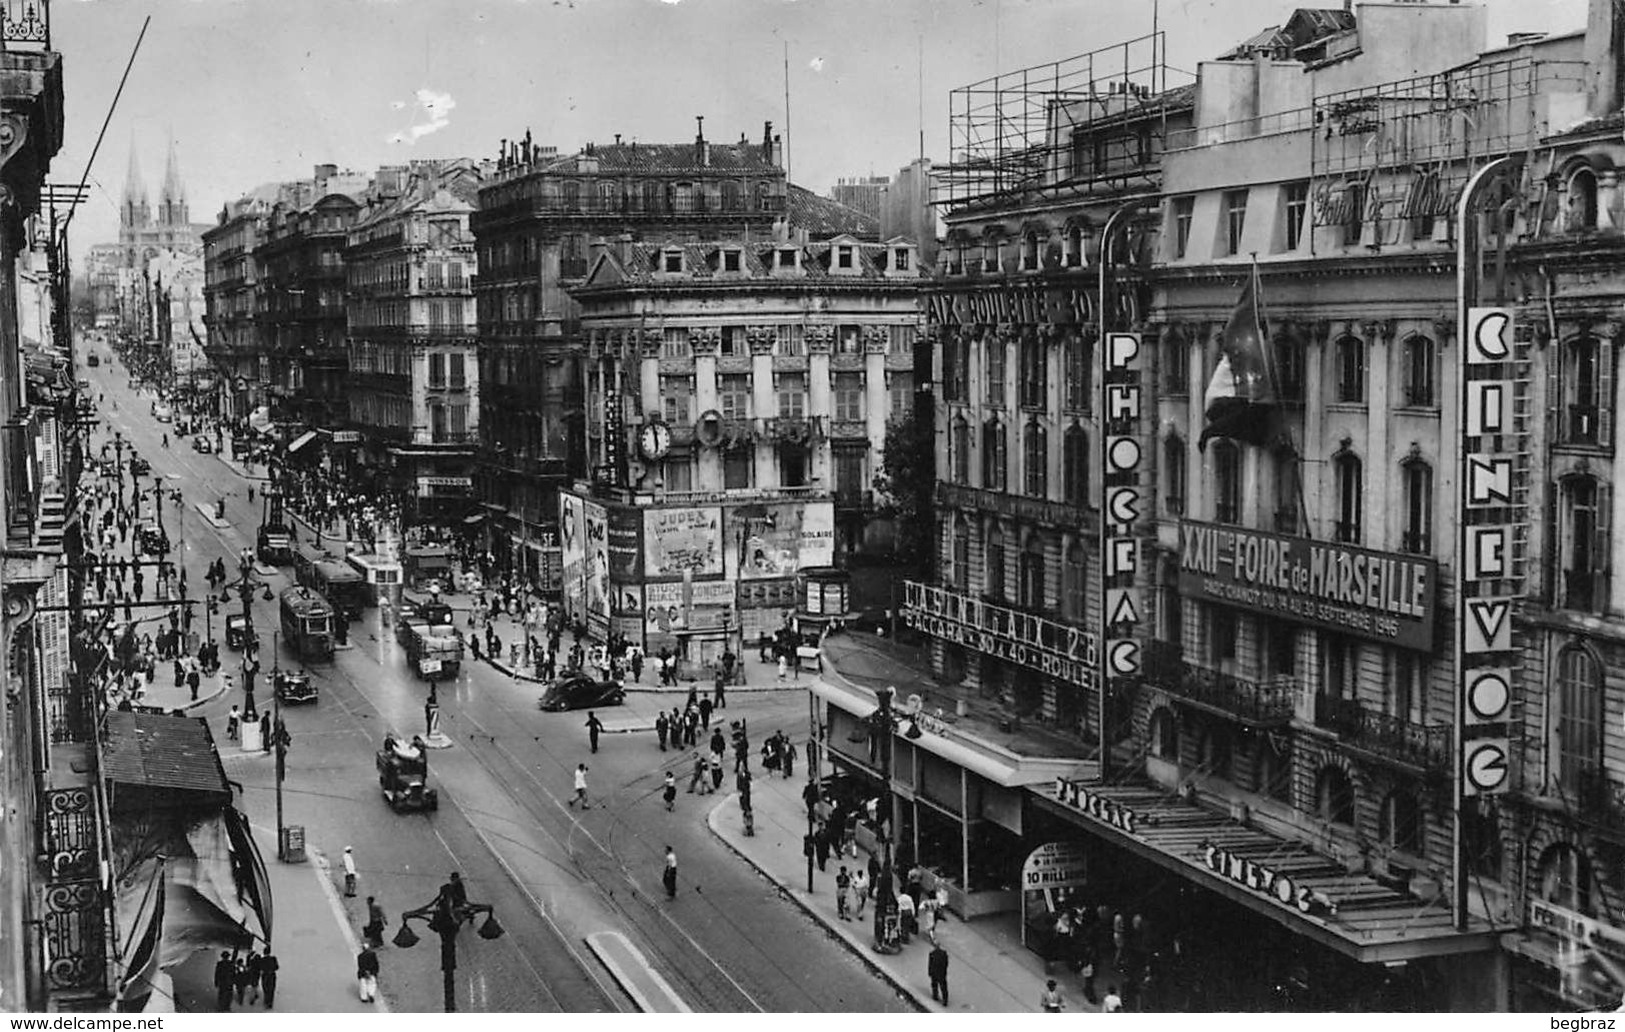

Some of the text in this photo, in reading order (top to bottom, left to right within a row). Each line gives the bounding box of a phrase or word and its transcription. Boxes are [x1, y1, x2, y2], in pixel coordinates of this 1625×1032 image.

[659, 509, 706, 526] JUDEX
[1466, 309, 1514, 794] CINEVOG
[1235, 533, 1291, 589] FOIRE
[1291, 557, 1308, 593] de
[1309, 546, 1427, 618] MARSEILLE
[905, 580, 983, 630] CASINO
[1317, 603, 1371, 631] SEPTEMBRE
[905, 609, 964, 645] BACCARA
[1027, 872, 1040, 884] 10
